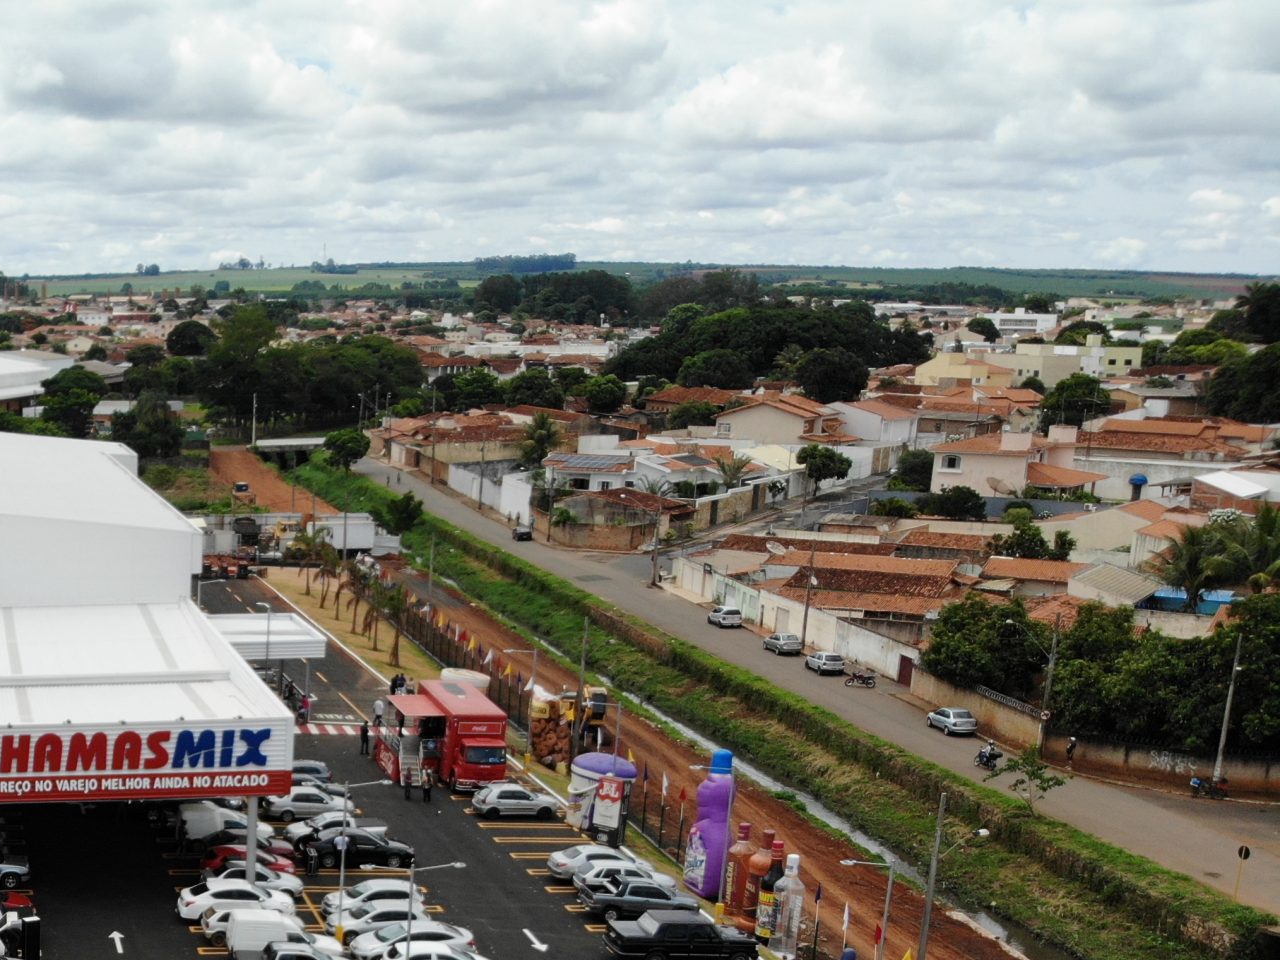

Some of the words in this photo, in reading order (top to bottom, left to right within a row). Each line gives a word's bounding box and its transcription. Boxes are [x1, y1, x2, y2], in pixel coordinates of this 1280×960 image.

[35, 780, 52, 793] NO
[55, 778, 98, 793] VAREJO
[101, 776, 151, 791] MELHOR
[153, 775, 190, 789] AINDA
[193, 775, 211, 788] NO
[213, 774, 268, 787] ATACADO
